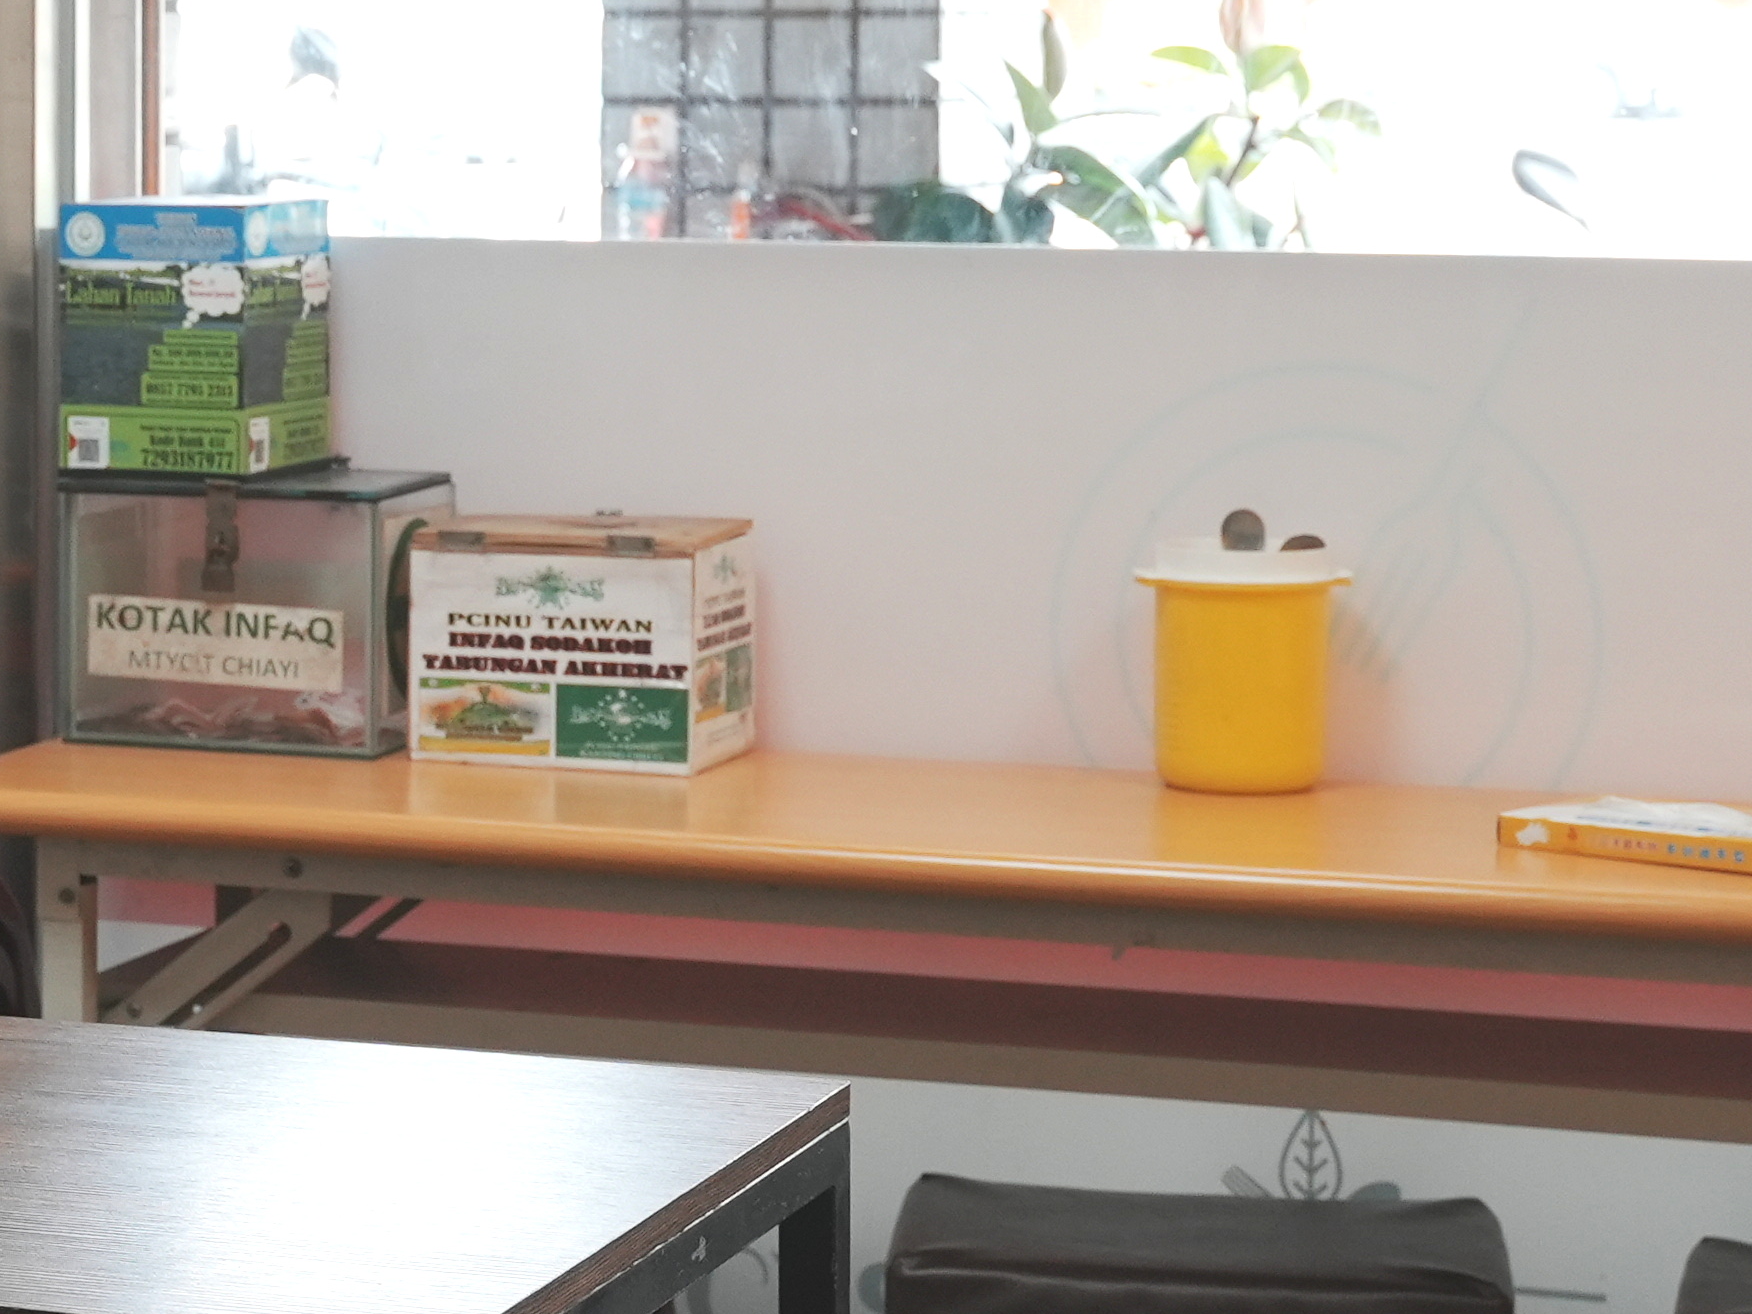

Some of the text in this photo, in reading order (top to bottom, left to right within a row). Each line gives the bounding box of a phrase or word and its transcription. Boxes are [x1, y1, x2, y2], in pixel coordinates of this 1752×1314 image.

[95, 601, 337, 649] KOTAK INFAQ
[447, 611, 654, 634] PCINU TAIWAN
[447, 631, 526, 651] INFAQ
[221, 655, 300, 680] CHIAYI
[422, 653, 557, 676] TABUNGAN
